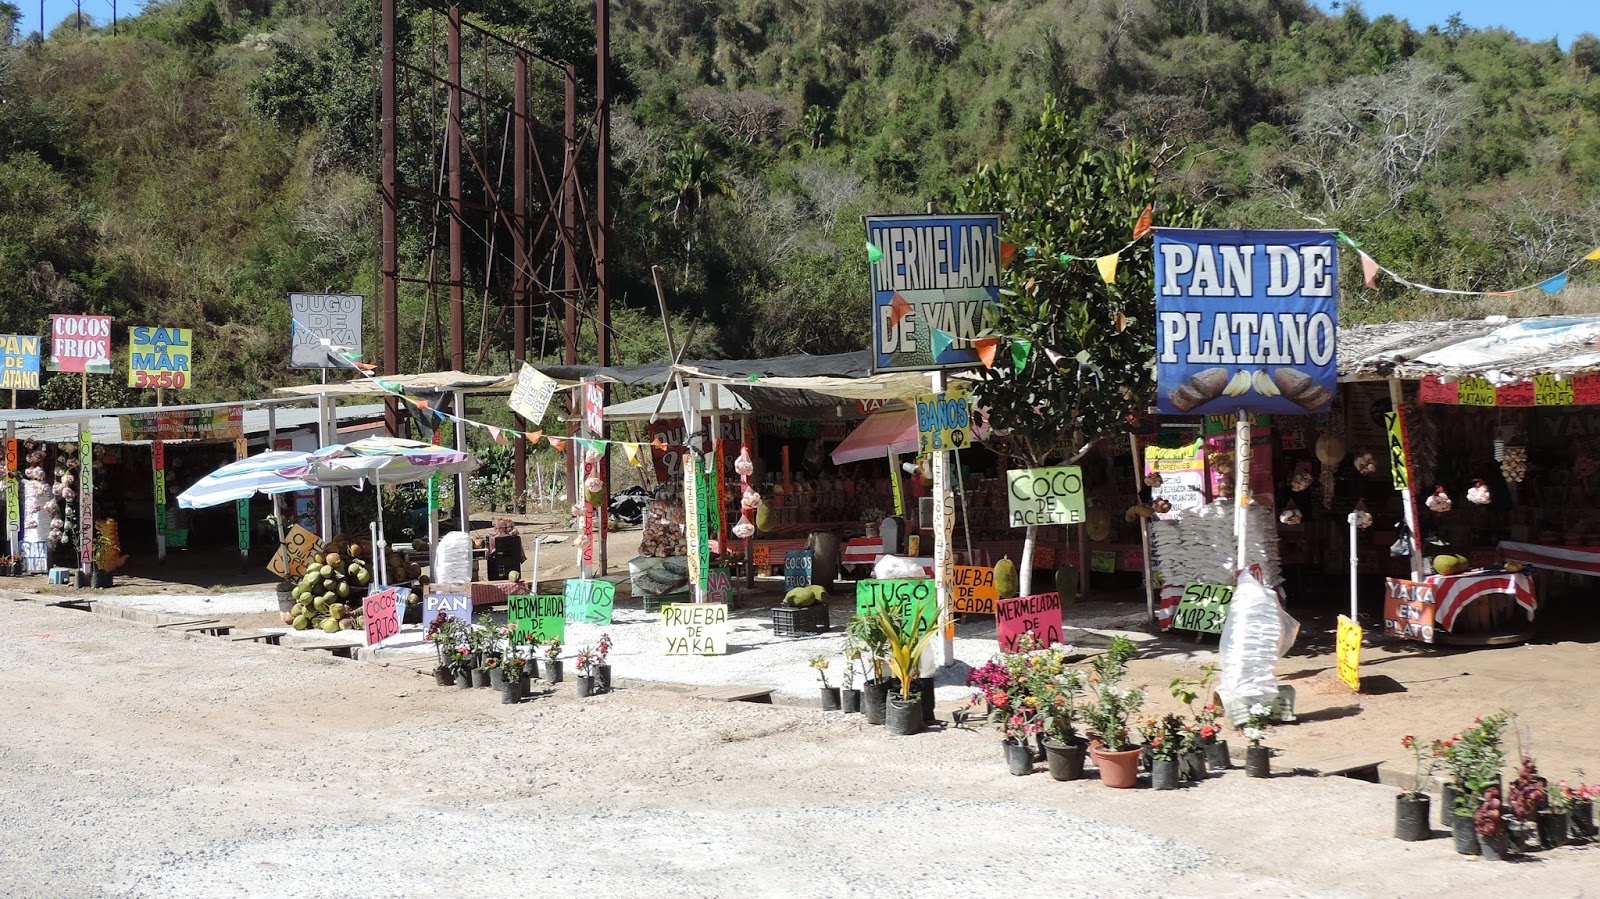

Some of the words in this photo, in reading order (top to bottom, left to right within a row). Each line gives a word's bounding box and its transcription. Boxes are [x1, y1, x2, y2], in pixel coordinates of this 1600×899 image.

[872, 223, 999, 292] MERMELADA
[1160, 243, 1255, 297] PAN
[1266, 243, 1333, 298] DE
[295, 295, 357, 313] JUGO
[55, 316, 110, 337] COCOS
[308, 313, 348, 329] DE
[880, 302, 916, 354] DE
[0, 336, 38, 356] PAN
[133, 328, 189, 347] SAL
[295, 329, 359, 346] YAKA
[1160, 312, 1336, 366] PLATANO
[54, 339, 107, 359] FRIOS
[5, 356, 24, 368] DE
[132, 352, 189, 372] MAR
[0, 369, 39, 389] ATANO
[135, 371, 186, 389] 3x50
[1535, 376, 1574, 392] YAKA
[511, 369, 536, 411] MIEL
[524, 387, 538, 406] DE
[530, 381, 556, 424] ABEJA
[859, 398, 891, 412] YAK
[917, 393, 968, 433] BAÑOS
[931, 431, 943, 449] 5
[80, 431, 90, 494] COCADA
[1010, 471, 1082, 501] COCO
[1035, 496, 1056, 512] DE
[1013, 510, 1079, 525] ACEITE
[689, 523, 698, 556] COCO
[291, 551, 306, 565] DE
[785, 556, 813, 570] COCOS
[785, 575, 813, 587] FRIOS
[952, 568, 994, 587] RUEBA
[861, 582, 929, 608] JUGO
[959, 587, 975, 597] DE
[1182, 584, 1218, 604] SAL
[1219, 588, 1234, 605] D
[1385, 582, 1436, 604] YAKA
[366, 591, 396, 619] COCOS
[427, 596, 468, 612] PAN
[508, 597, 564, 620] MERMELADA
[952, 597, 994, 613] CADA
[996, 594, 1060, 624] MERMELADA
[1398, 604, 1420, 620] EN
[530, 618, 544, 630] DE
[566, 612, 585, 622] QUI
[662, 607, 726, 627] PRUEBA
[1023, 617, 1040, 632] DE
[1173, 608, 1206, 630] MAR
[1204, 610, 1227, 631] 3X
[368, 610, 399, 645] FRIOS
[686, 626, 703, 638] DE
[1005, 625, 1060, 650] YKA
[1385, 619, 1434, 640] PLATO
[666, 637, 715, 654] YAKA
